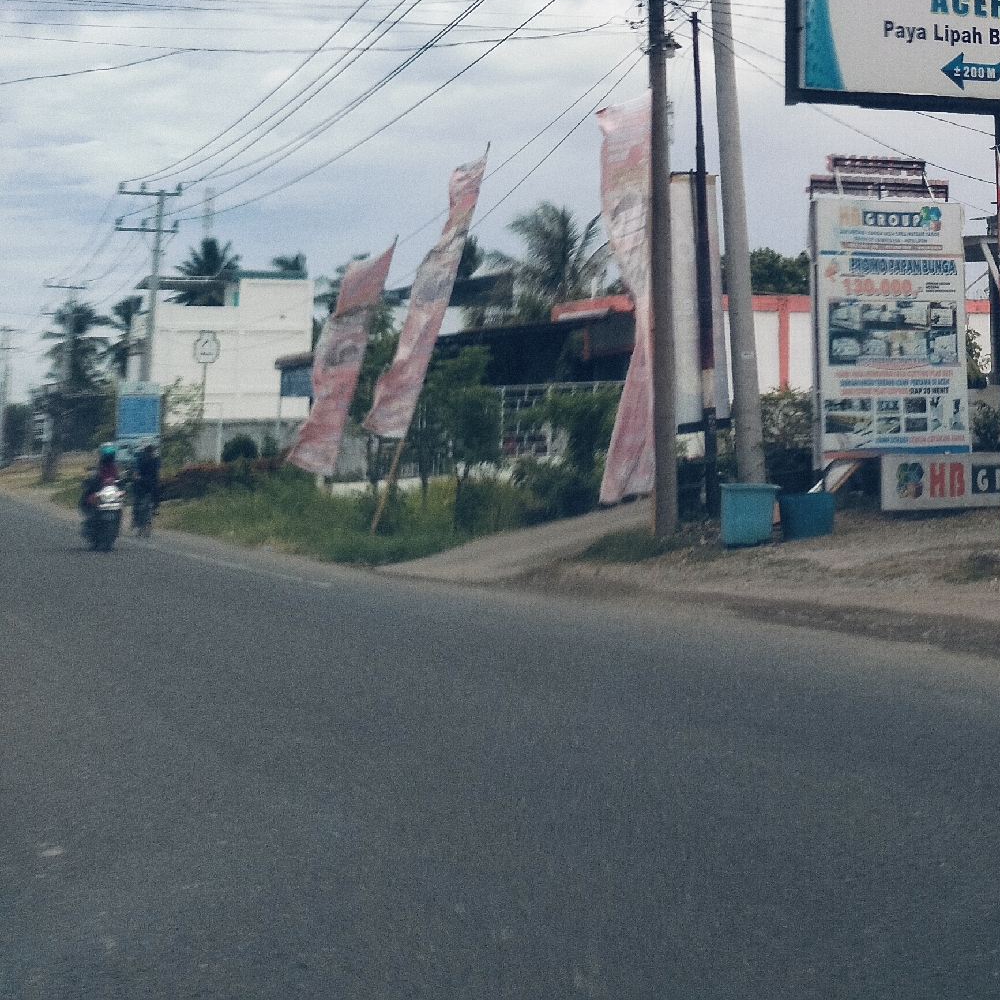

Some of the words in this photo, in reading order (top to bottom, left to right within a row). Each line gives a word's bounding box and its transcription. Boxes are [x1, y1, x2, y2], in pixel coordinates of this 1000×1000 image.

[884, 20, 927, 43] Paya
[933, 23, 983, 46] Lipah
[963, 66, 985, 79] 200
[865, 212, 920, 227] GROUP
[921, 260, 957, 276] BUNGA
[929, 462, 965, 497] HB
